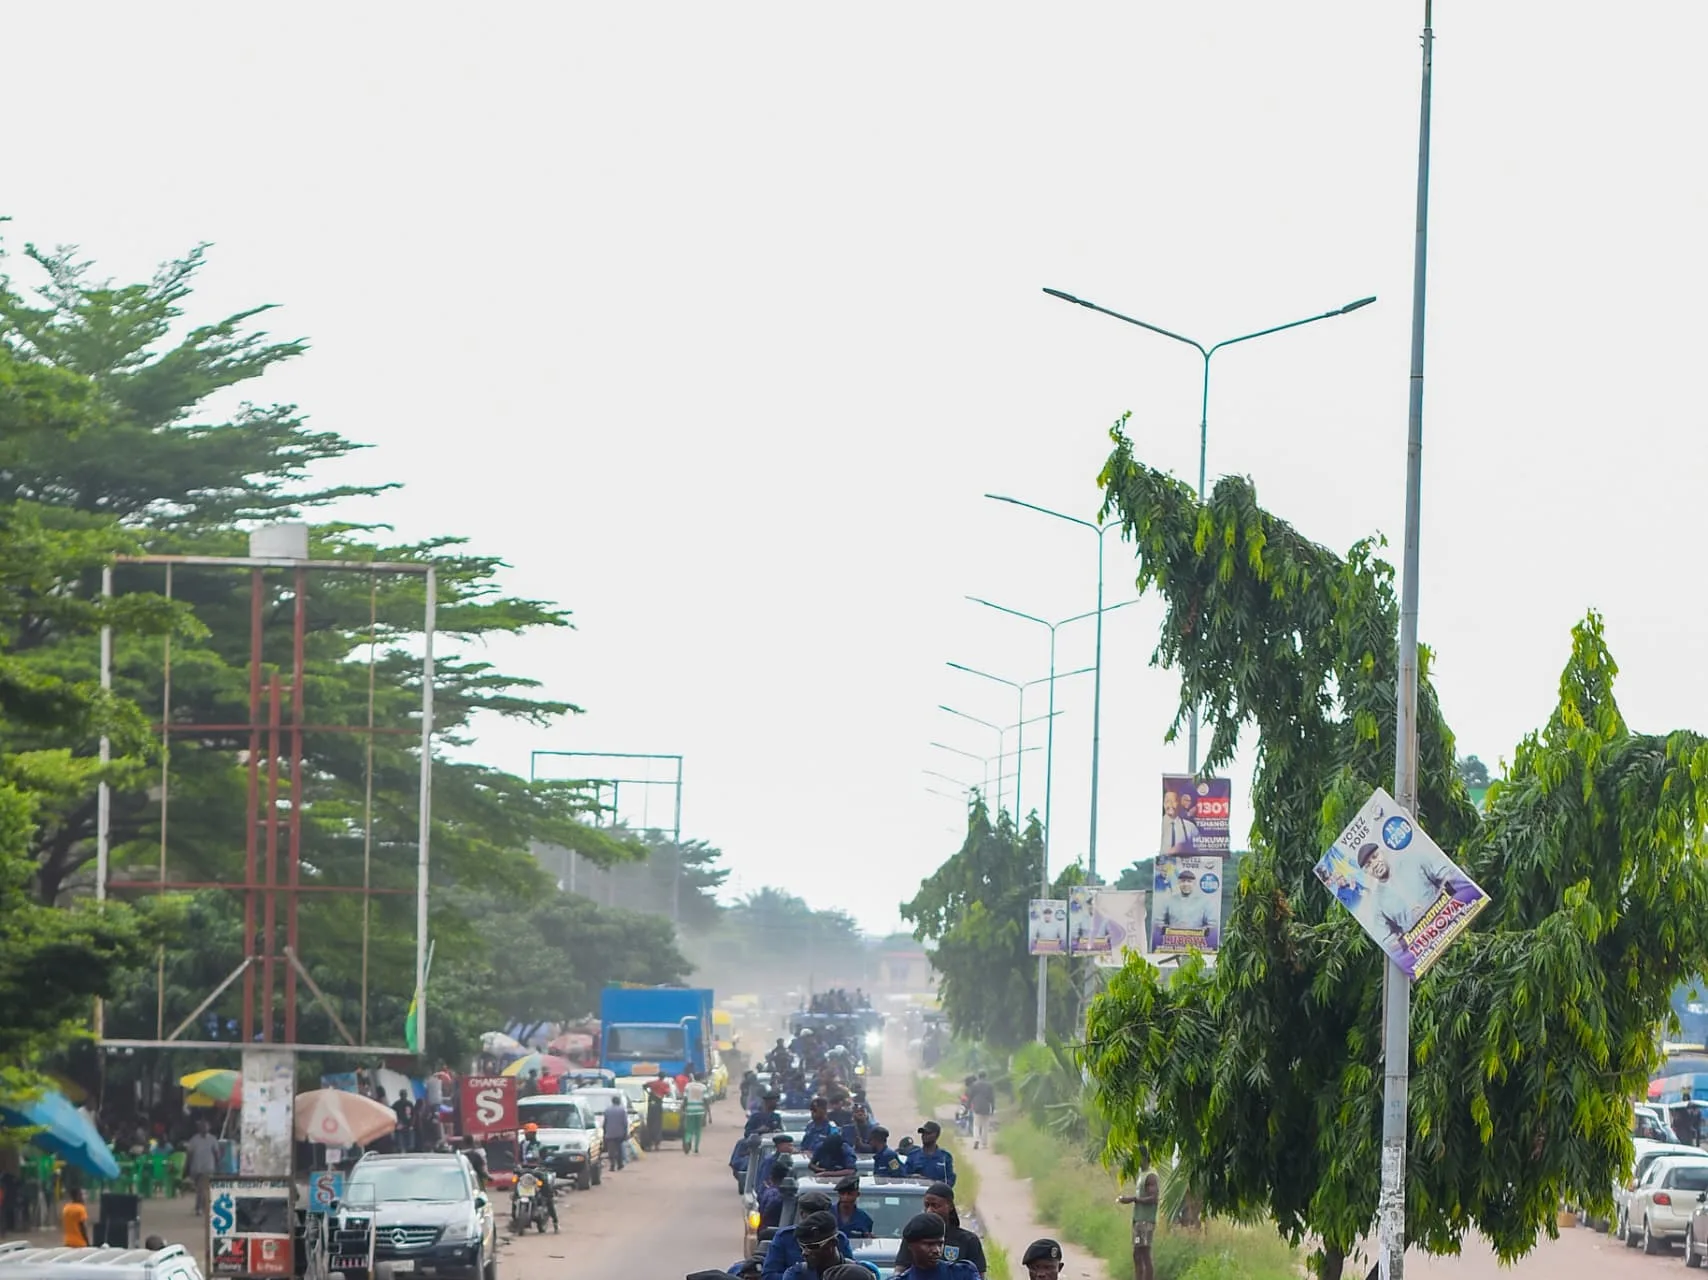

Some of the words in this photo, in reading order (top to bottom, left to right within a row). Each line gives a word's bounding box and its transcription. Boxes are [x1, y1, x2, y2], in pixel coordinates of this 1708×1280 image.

[1196, 801, 1229, 814] 1301
[1341, 816, 1366, 845] VOTEZ
[1349, 826, 1370, 850] TOUS
[1403, 888, 1451, 945] Emmanuel
[1408, 899, 1465, 958] LUBOYA
[468, 1077, 508, 1088] CHANGE
